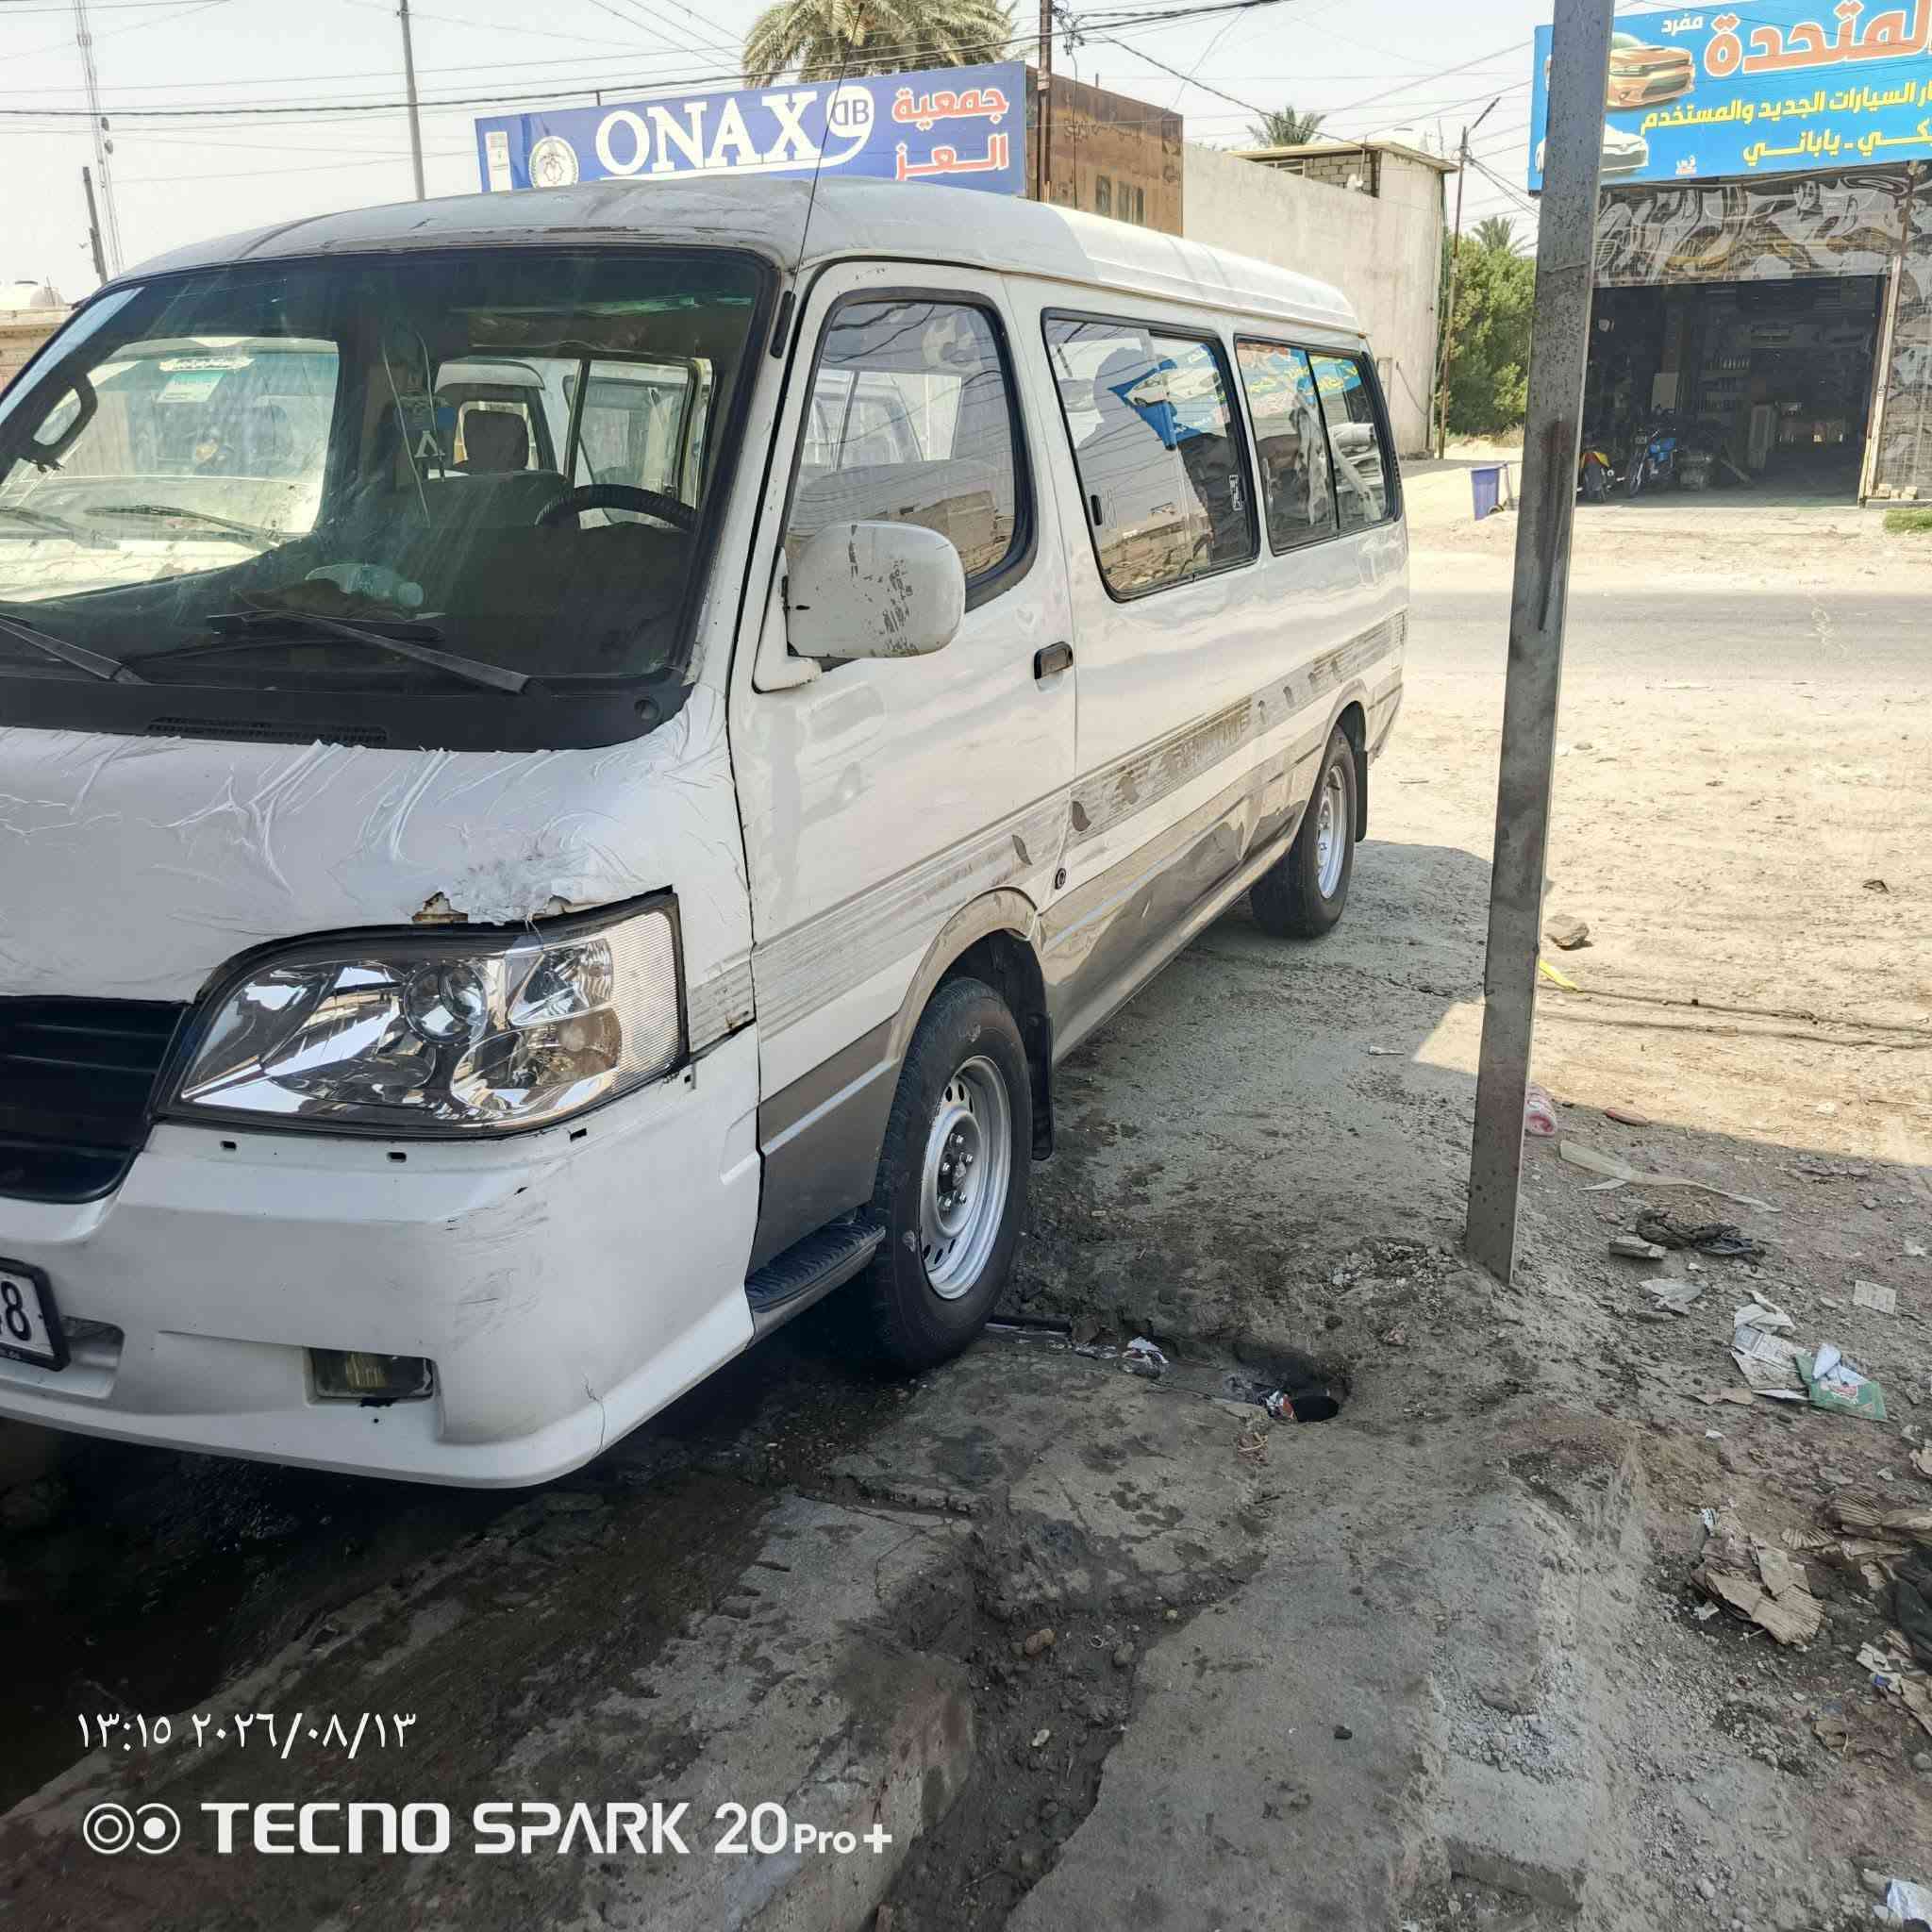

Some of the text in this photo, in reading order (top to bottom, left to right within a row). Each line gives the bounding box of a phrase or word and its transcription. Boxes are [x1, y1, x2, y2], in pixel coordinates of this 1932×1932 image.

[1661, 12, 1703, 36] مفرد
[1704, 0, 1932, 76] لمتحدة
[891, 87, 1010, 130] جمعية
[1757, 91, 1826, 121] الجديد
[1828, 81, 1917, 114] السيارات
[596, 92, 823, 175] ONAX
[1640, 98, 1755, 137] والمستخدم
[1742, 128, 1840, 166] ياباني
[0, 1280, 32, 1341] 8
